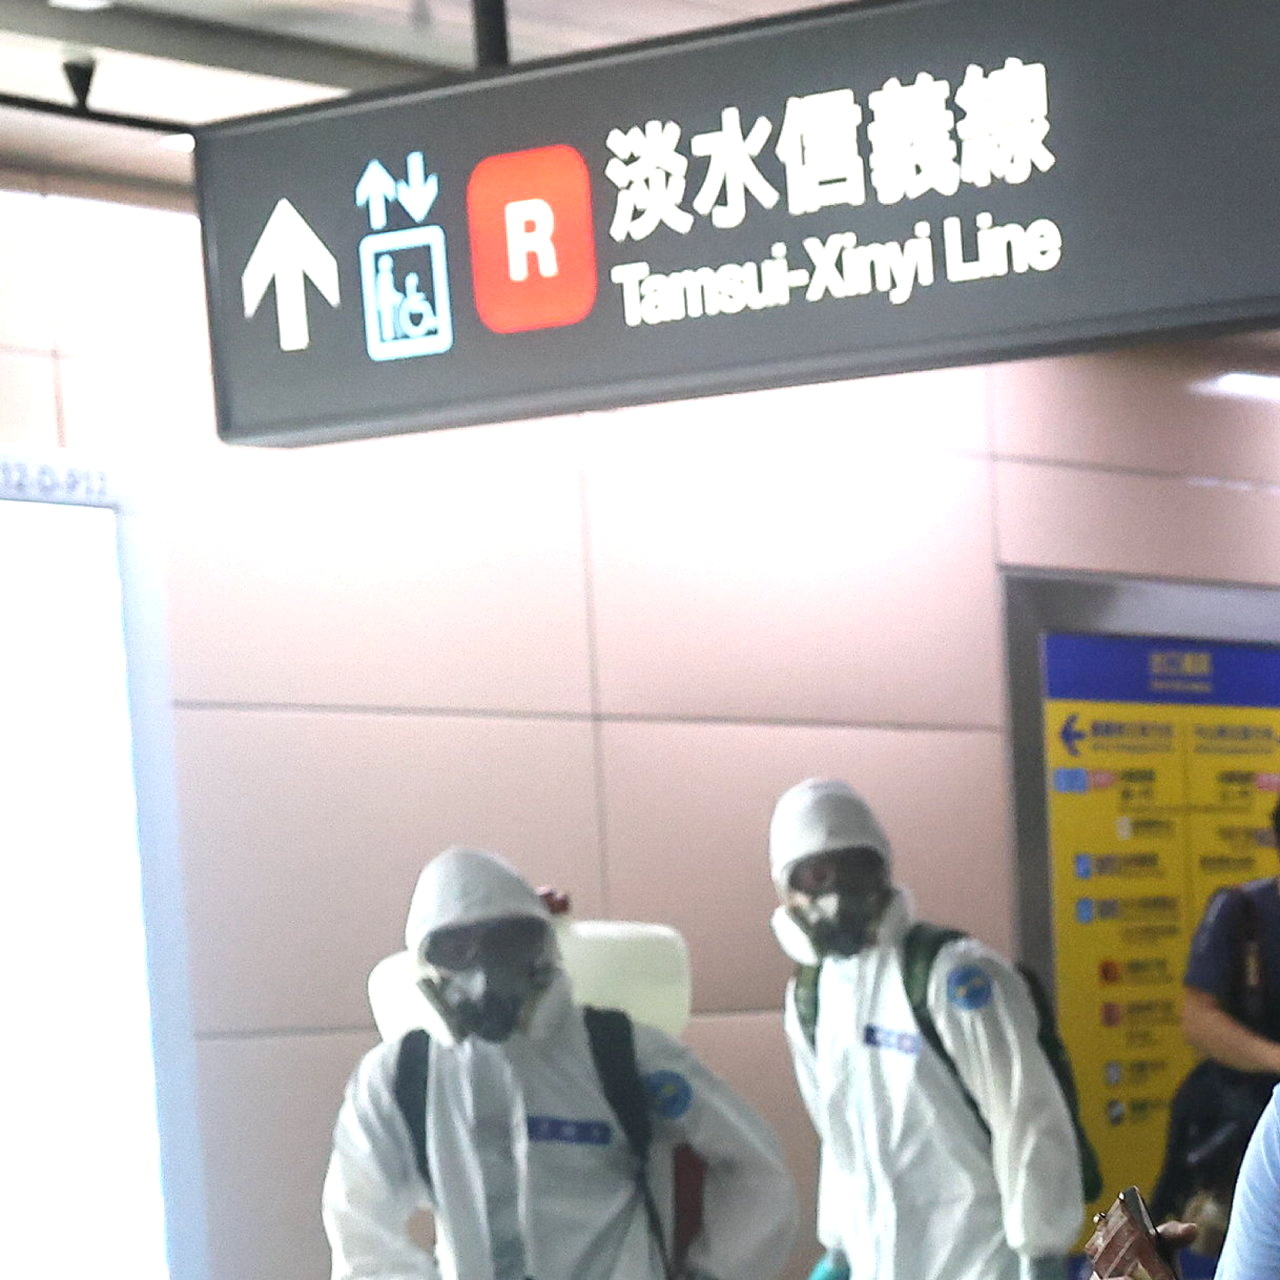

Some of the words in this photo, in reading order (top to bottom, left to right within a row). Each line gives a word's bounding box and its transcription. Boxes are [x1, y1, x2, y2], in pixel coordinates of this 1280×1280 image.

[604, 56, 1056, 241] 淡水信義線
[503, 197, 560, 283] R
[610, 220, 934, 327] Tamsui-Xinyi
[943, 211, 1063, 283] Line
